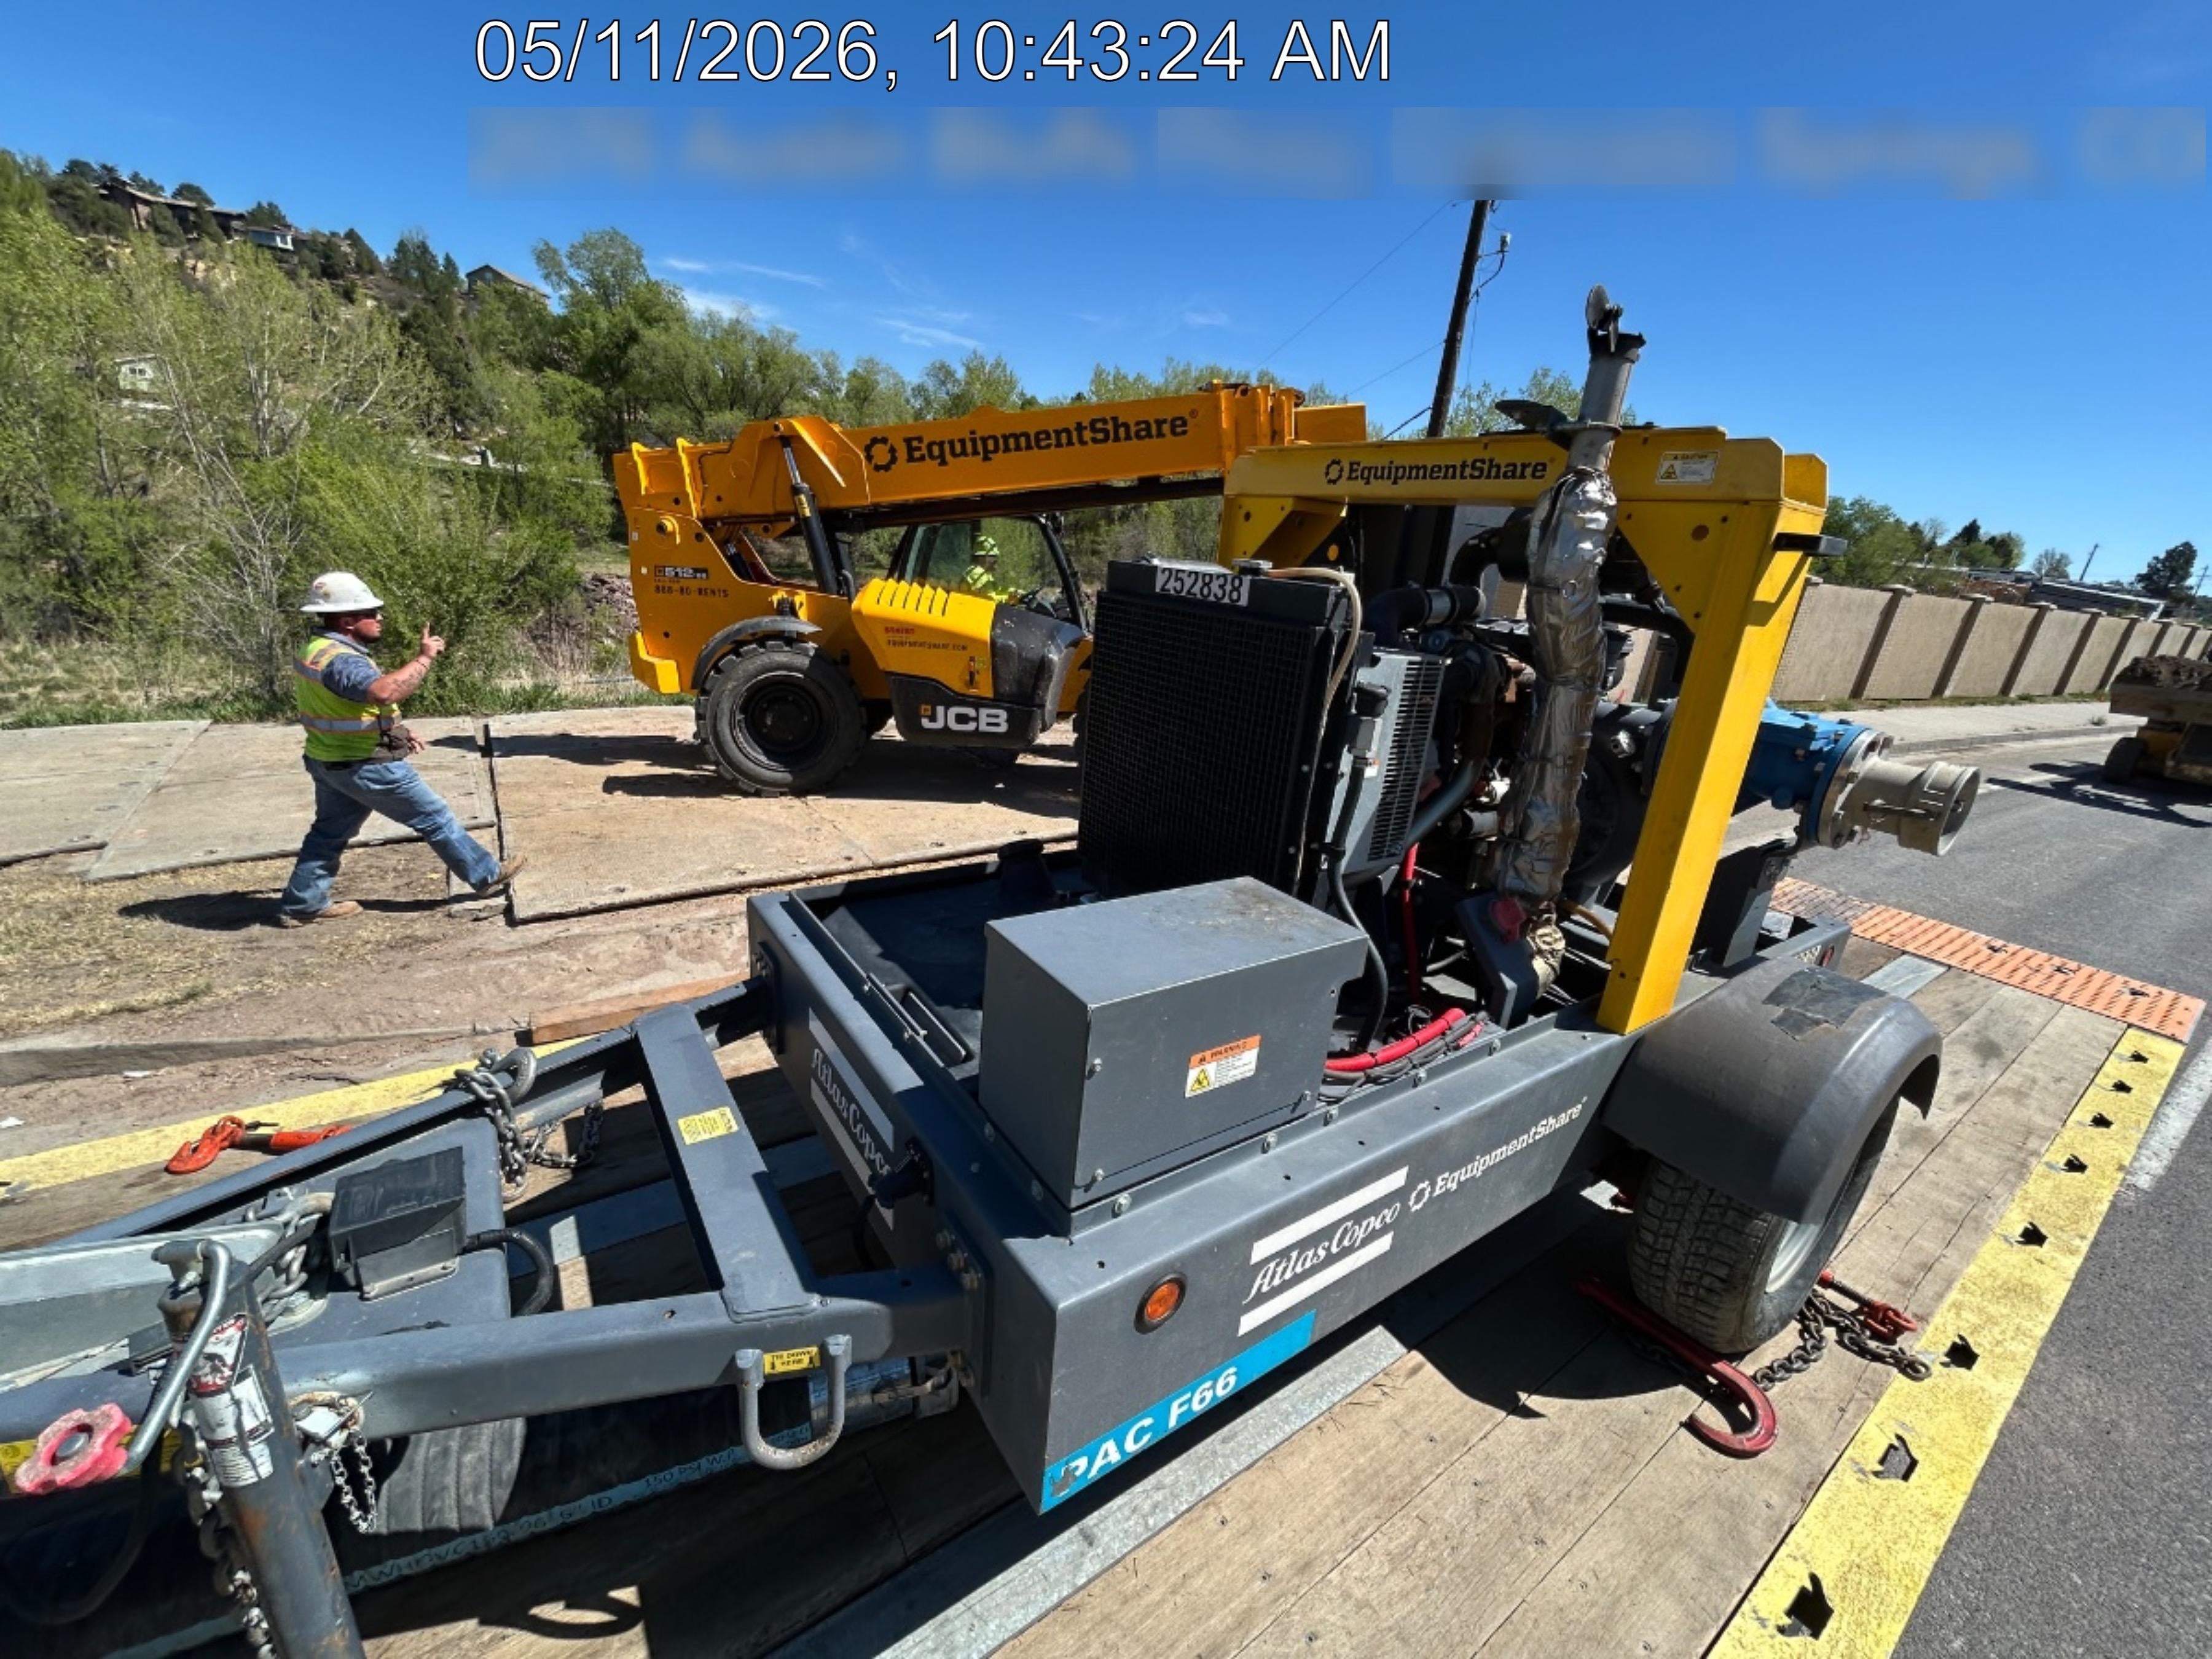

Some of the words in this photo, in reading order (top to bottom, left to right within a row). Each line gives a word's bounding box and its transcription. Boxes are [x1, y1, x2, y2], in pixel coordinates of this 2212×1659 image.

[903, 415, 1188, 466] EquipmentShare
[1346, 458, 1548, 485] EquipmentShare
[1159, 567, 1243, 603] 252838
[920, 705, 1009, 733] JCB
[1432, 1103, 1582, 1197] EquipmentShare
[1167, 1367, 1237, 1429] F66
